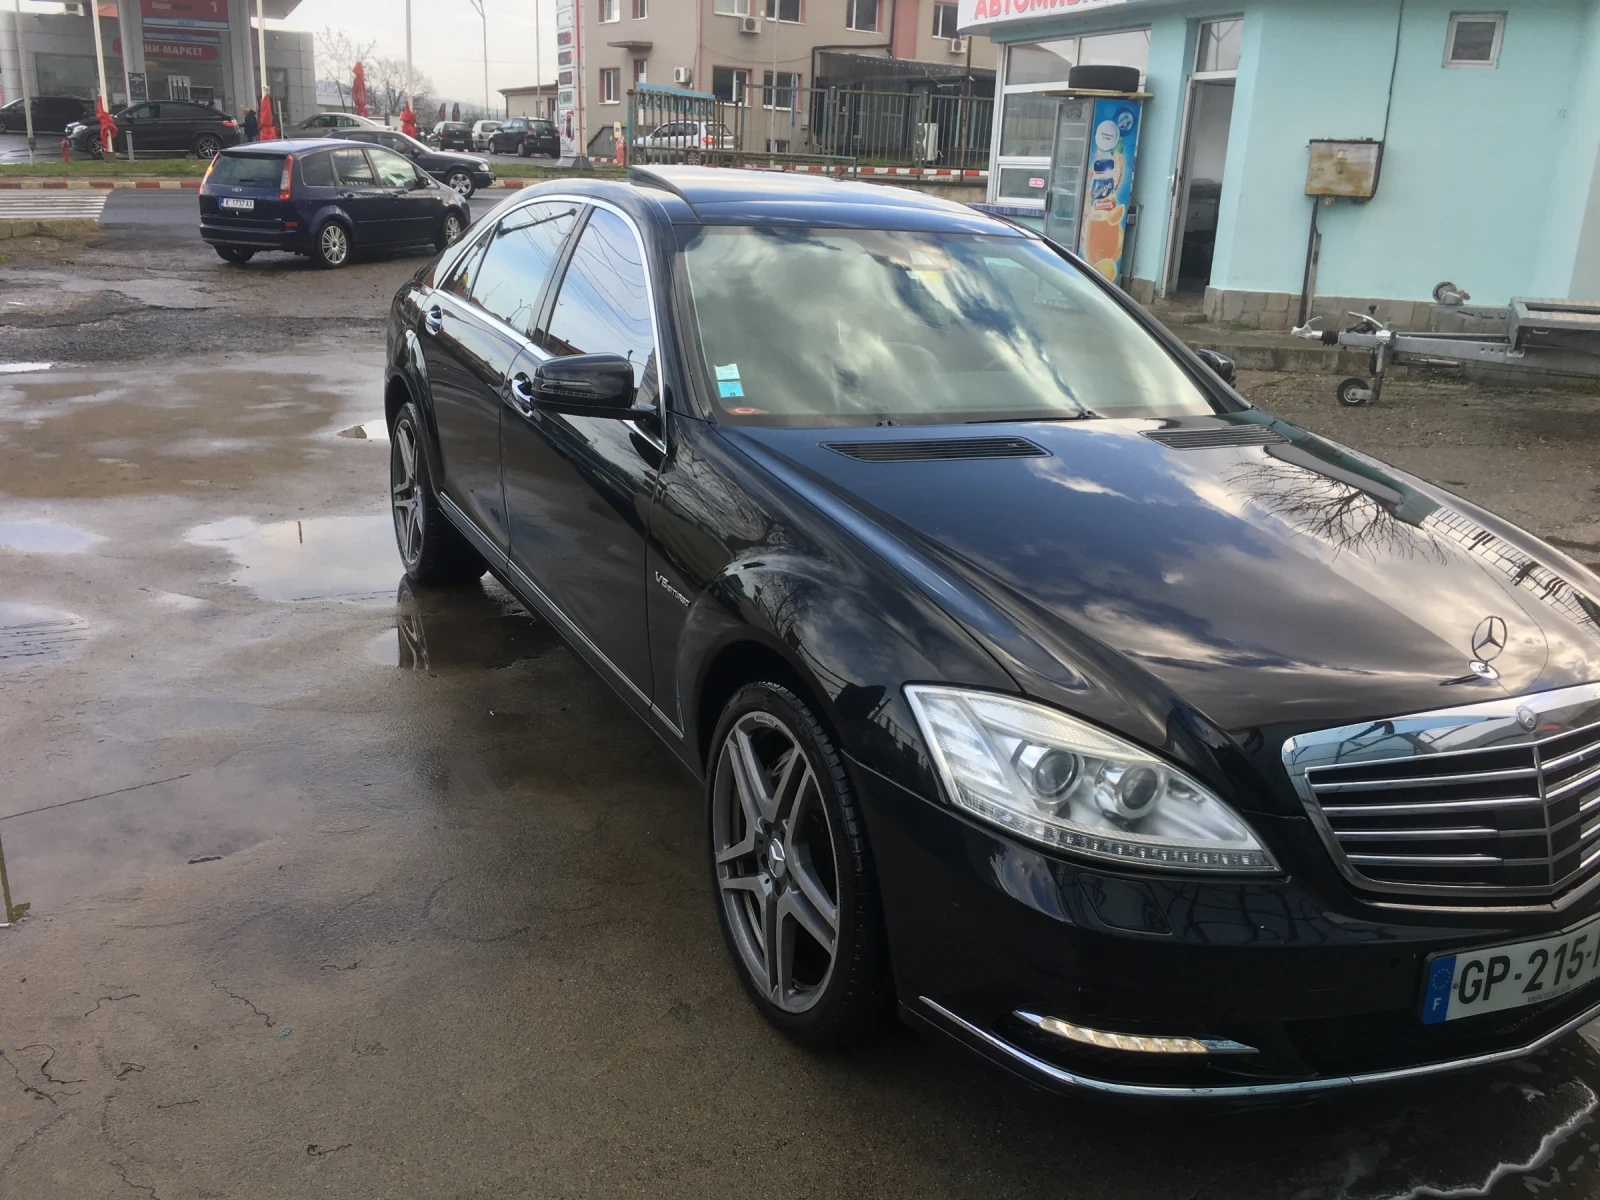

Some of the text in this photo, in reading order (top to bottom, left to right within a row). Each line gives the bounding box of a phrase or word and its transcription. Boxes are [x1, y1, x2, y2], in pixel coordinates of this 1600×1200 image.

[209, 1, 218, 13] 1
[144, 43, 203, 56] НИ-МАРКЕТ
[1458, 932, 1600, 1004] GP-215-
[1432, 997, 1442, 1011] F
